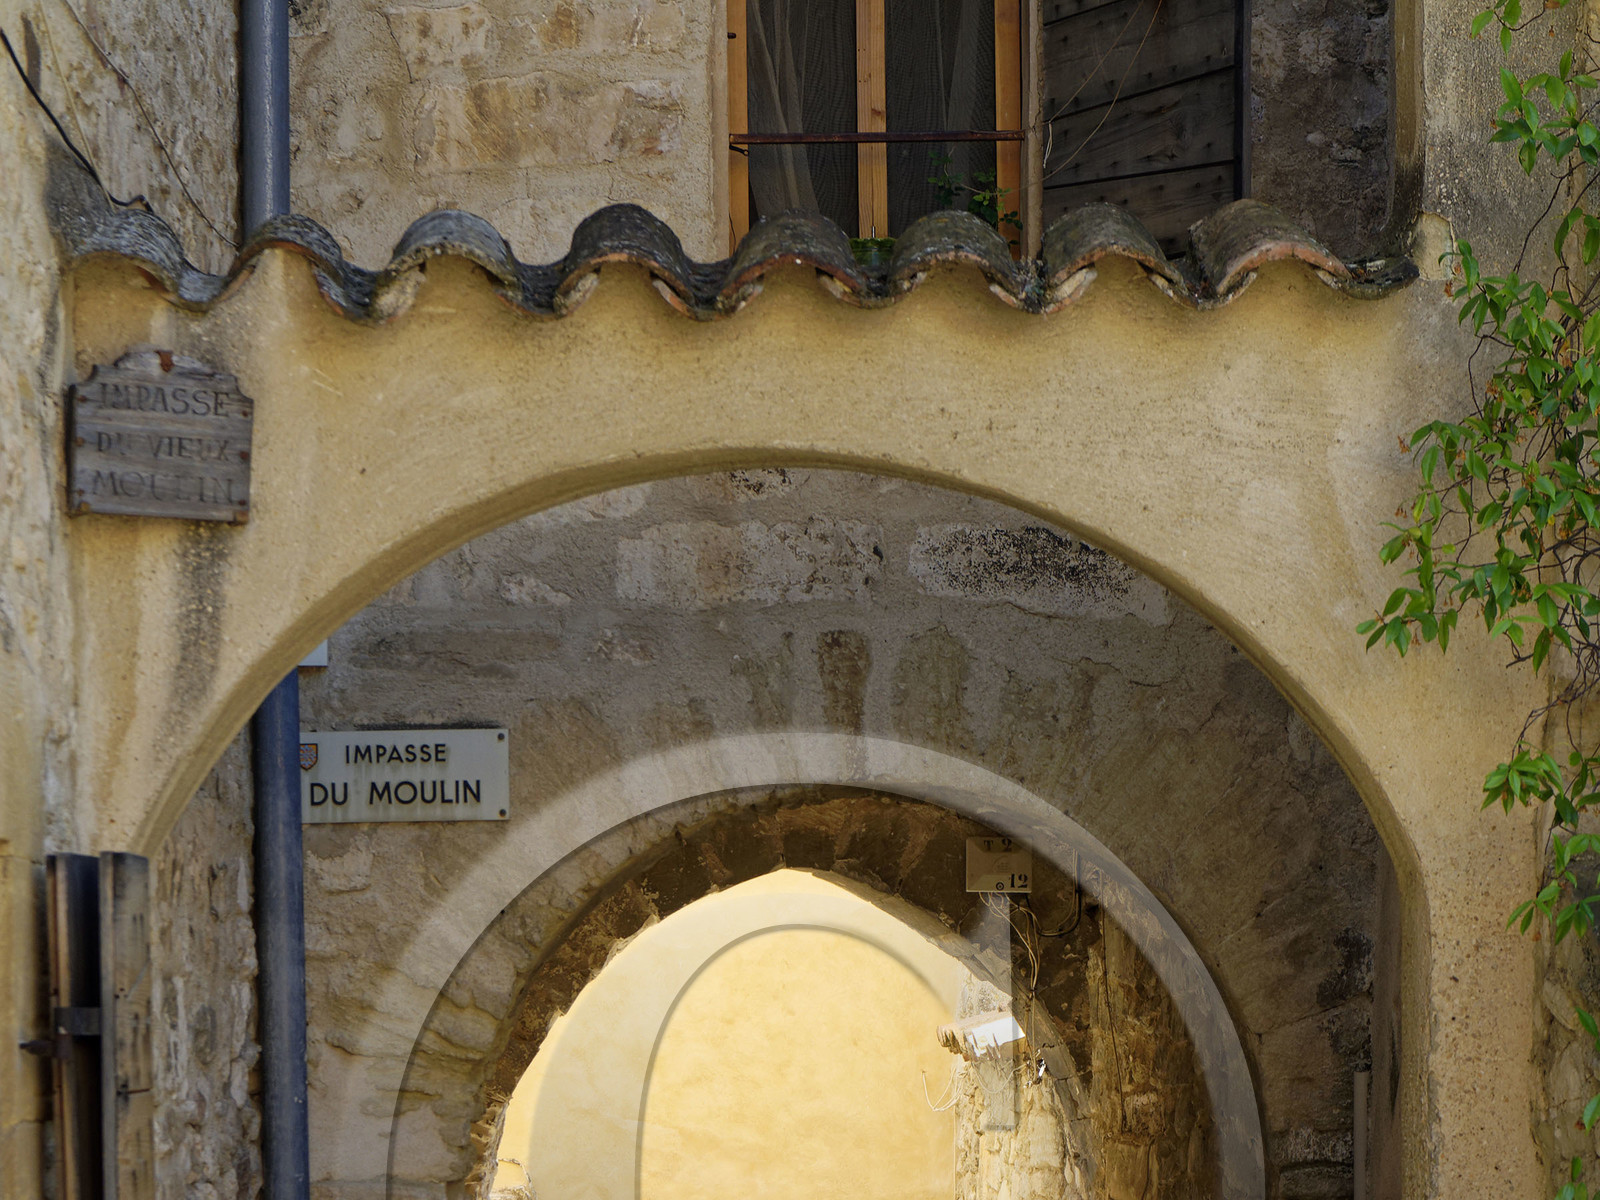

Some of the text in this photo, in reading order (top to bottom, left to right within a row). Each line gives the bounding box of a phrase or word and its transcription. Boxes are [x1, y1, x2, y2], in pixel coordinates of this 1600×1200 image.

[98, 382, 231, 417] IMPASSE
[148, 434, 231, 462] VIEUX
[92, 469, 235, 505] MOULIN
[345, 743, 447, 764] IMPASSE
[310, 779, 482, 806] DU MOULIN
